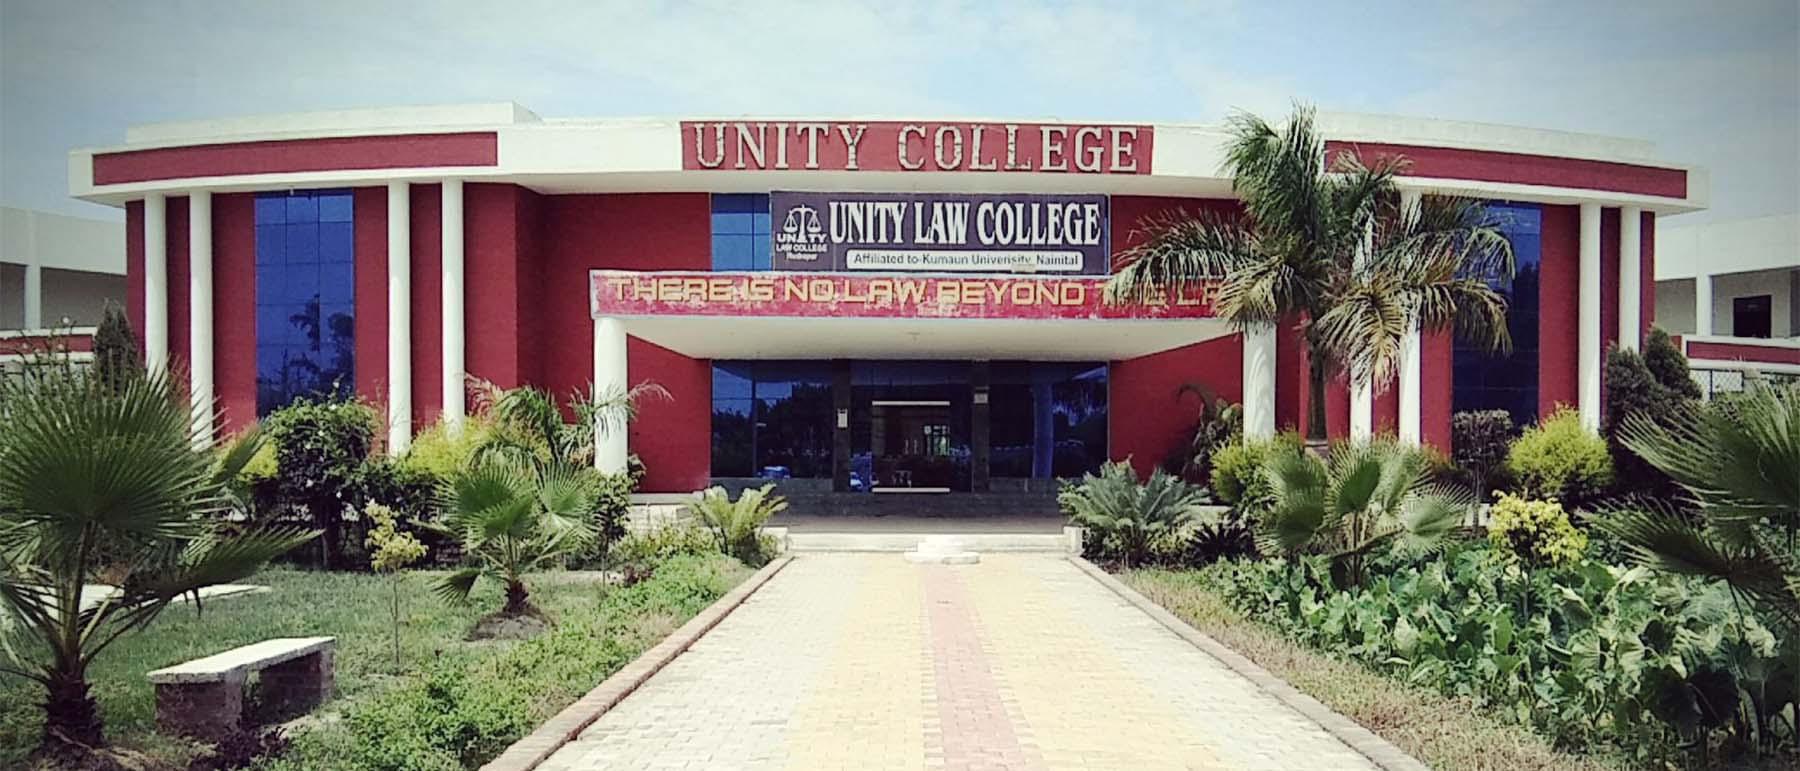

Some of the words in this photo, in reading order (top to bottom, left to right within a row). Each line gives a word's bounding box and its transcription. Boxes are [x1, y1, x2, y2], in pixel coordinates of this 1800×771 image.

[694, 122, 867, 171] UNITY
[898, 124, 1138, 173] COLLEGE
[829, 201, 908, 244] UNITY
[914, 202, 970, 245] LAW
[976, 202, 1101, 246] COLLEGE
[775, 243, 793, 252] LAW
[793, 243, 828, 252] COLLEGE
[854, 253, 904, 265] Affiliated
[922, 253, 969, 265] Kumaun
[1036, 254, 1079, 266] Nainital
[607, 277, 733, 301] THERE
[741, 278, 774, 302] IS
[784, 278, 835, 302] NO
[843, 279, 927, 303] LAW
[937, 280, 1086, 305] BEYOND
[1094, 282, 1168, 306] TE
